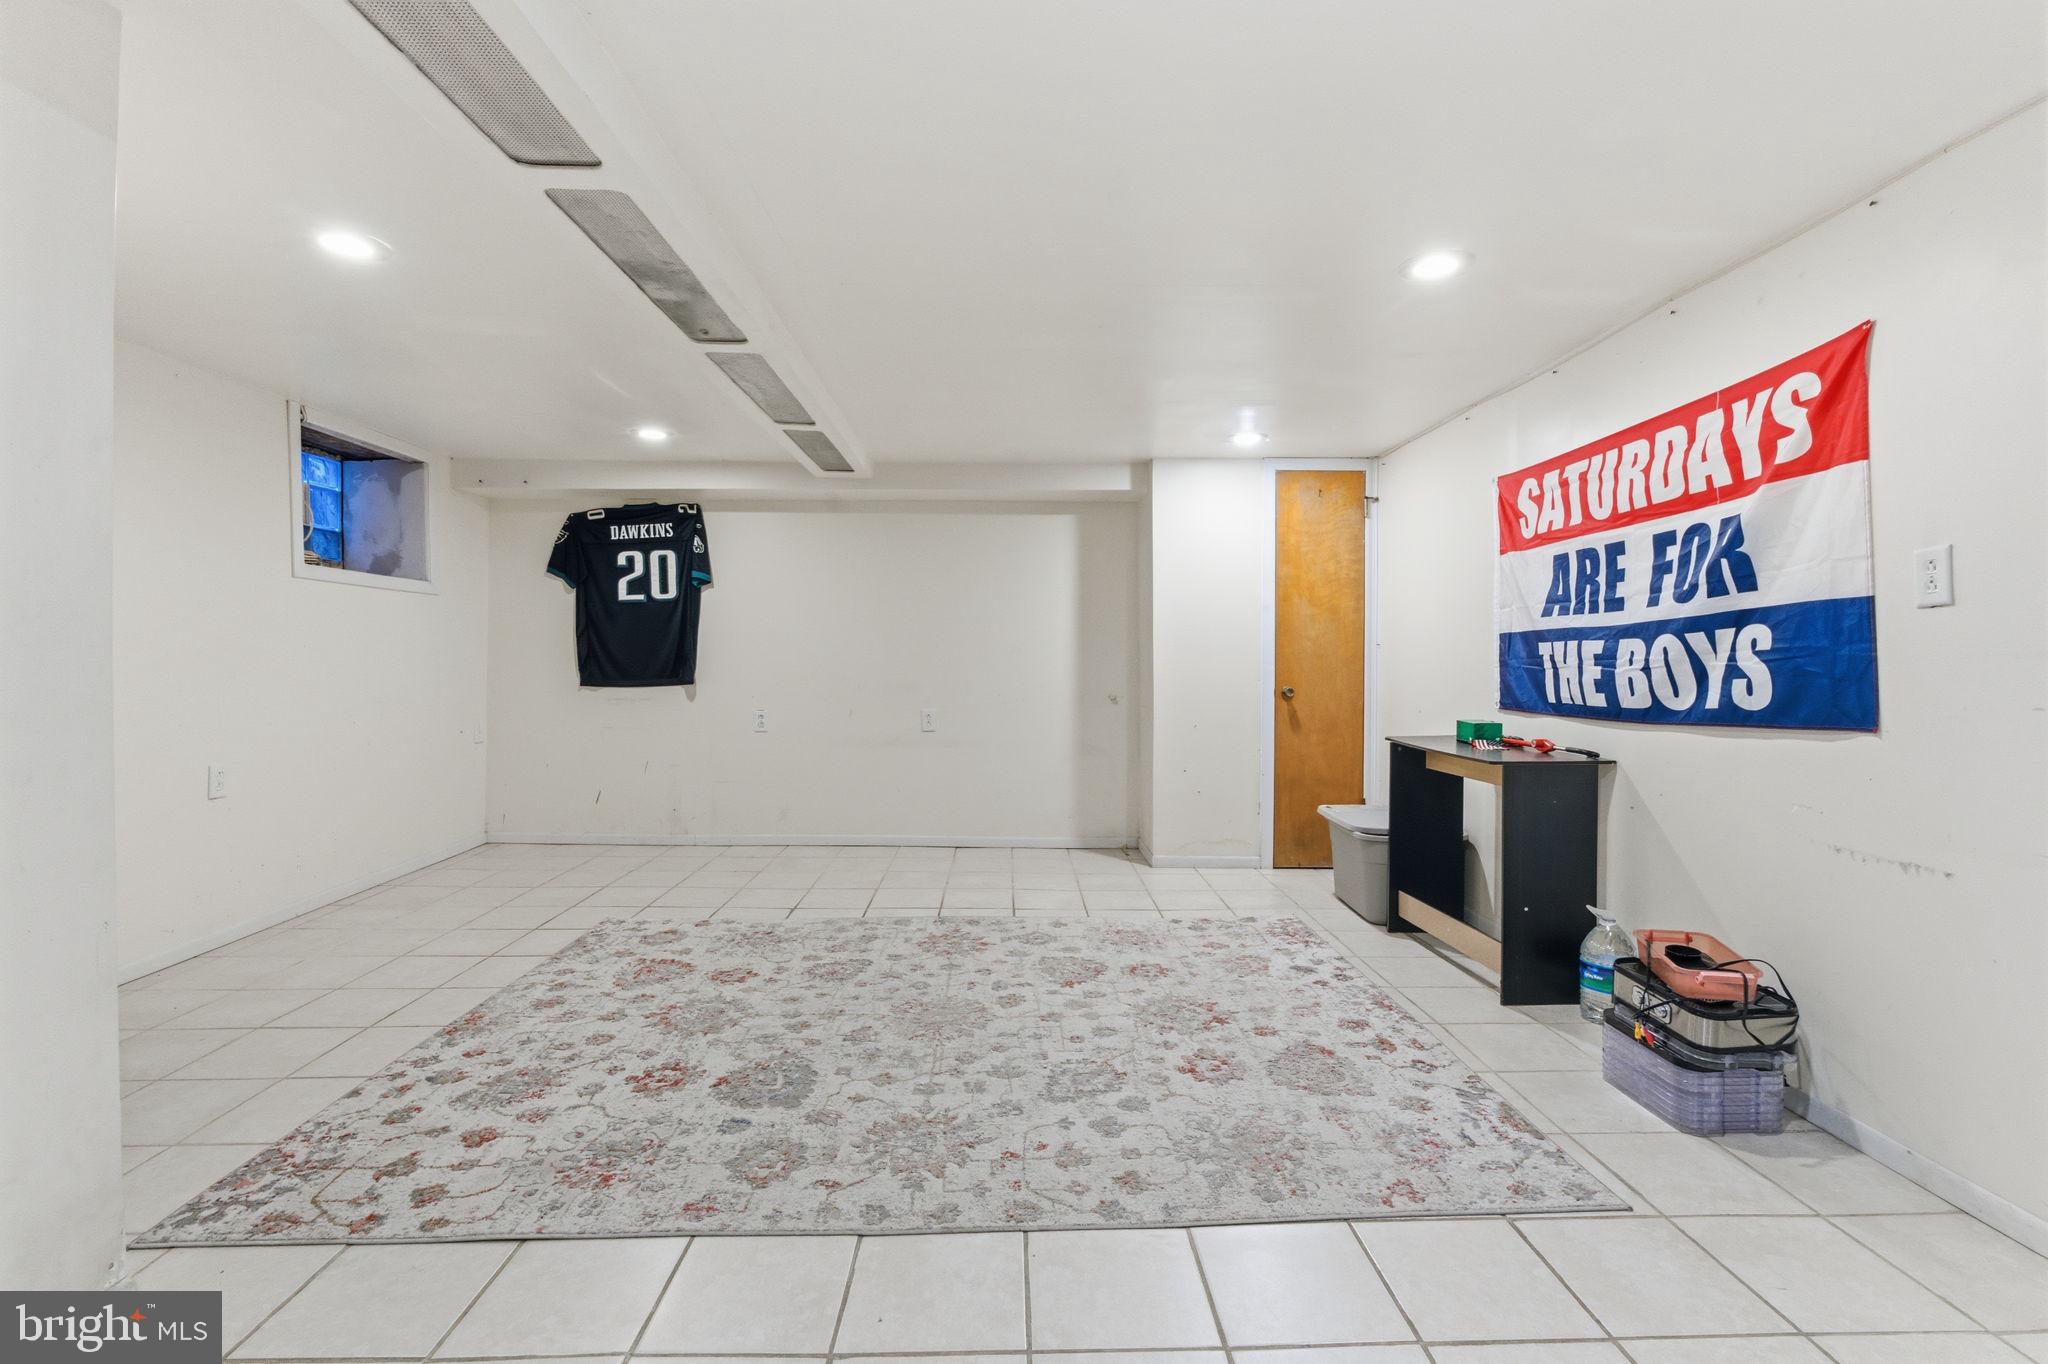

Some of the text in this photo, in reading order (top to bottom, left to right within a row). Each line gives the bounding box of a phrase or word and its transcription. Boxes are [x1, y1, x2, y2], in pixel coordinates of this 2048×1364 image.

[1517, 371, 1822, 540] SATURDAYS
[610, 522, 674, 540] DAWKINS
[617, 549, 678, 601] 20
[1540, 513, 1759, 618] ARE FOR
[1538, 623, 1773, 711] THE BOYS
